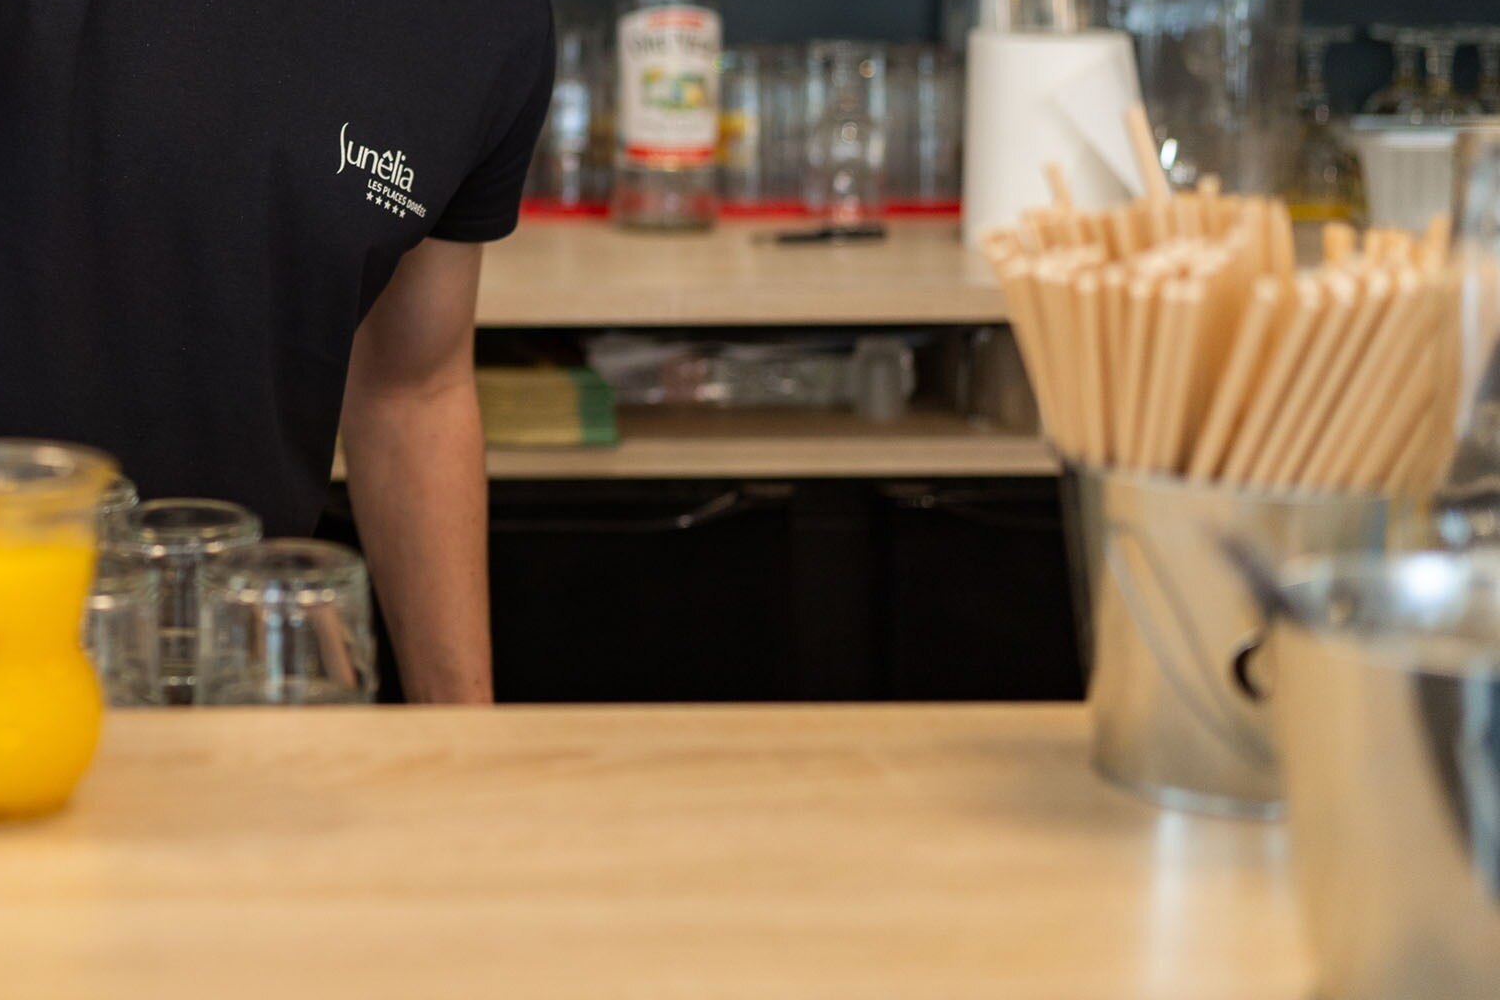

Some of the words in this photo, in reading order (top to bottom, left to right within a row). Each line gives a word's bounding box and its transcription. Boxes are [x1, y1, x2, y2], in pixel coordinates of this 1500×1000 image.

[336, 121, 414, 192] Sunêlia
[367, 178, 383, 193] LES
[382, 185, 407, 206] PLACES
